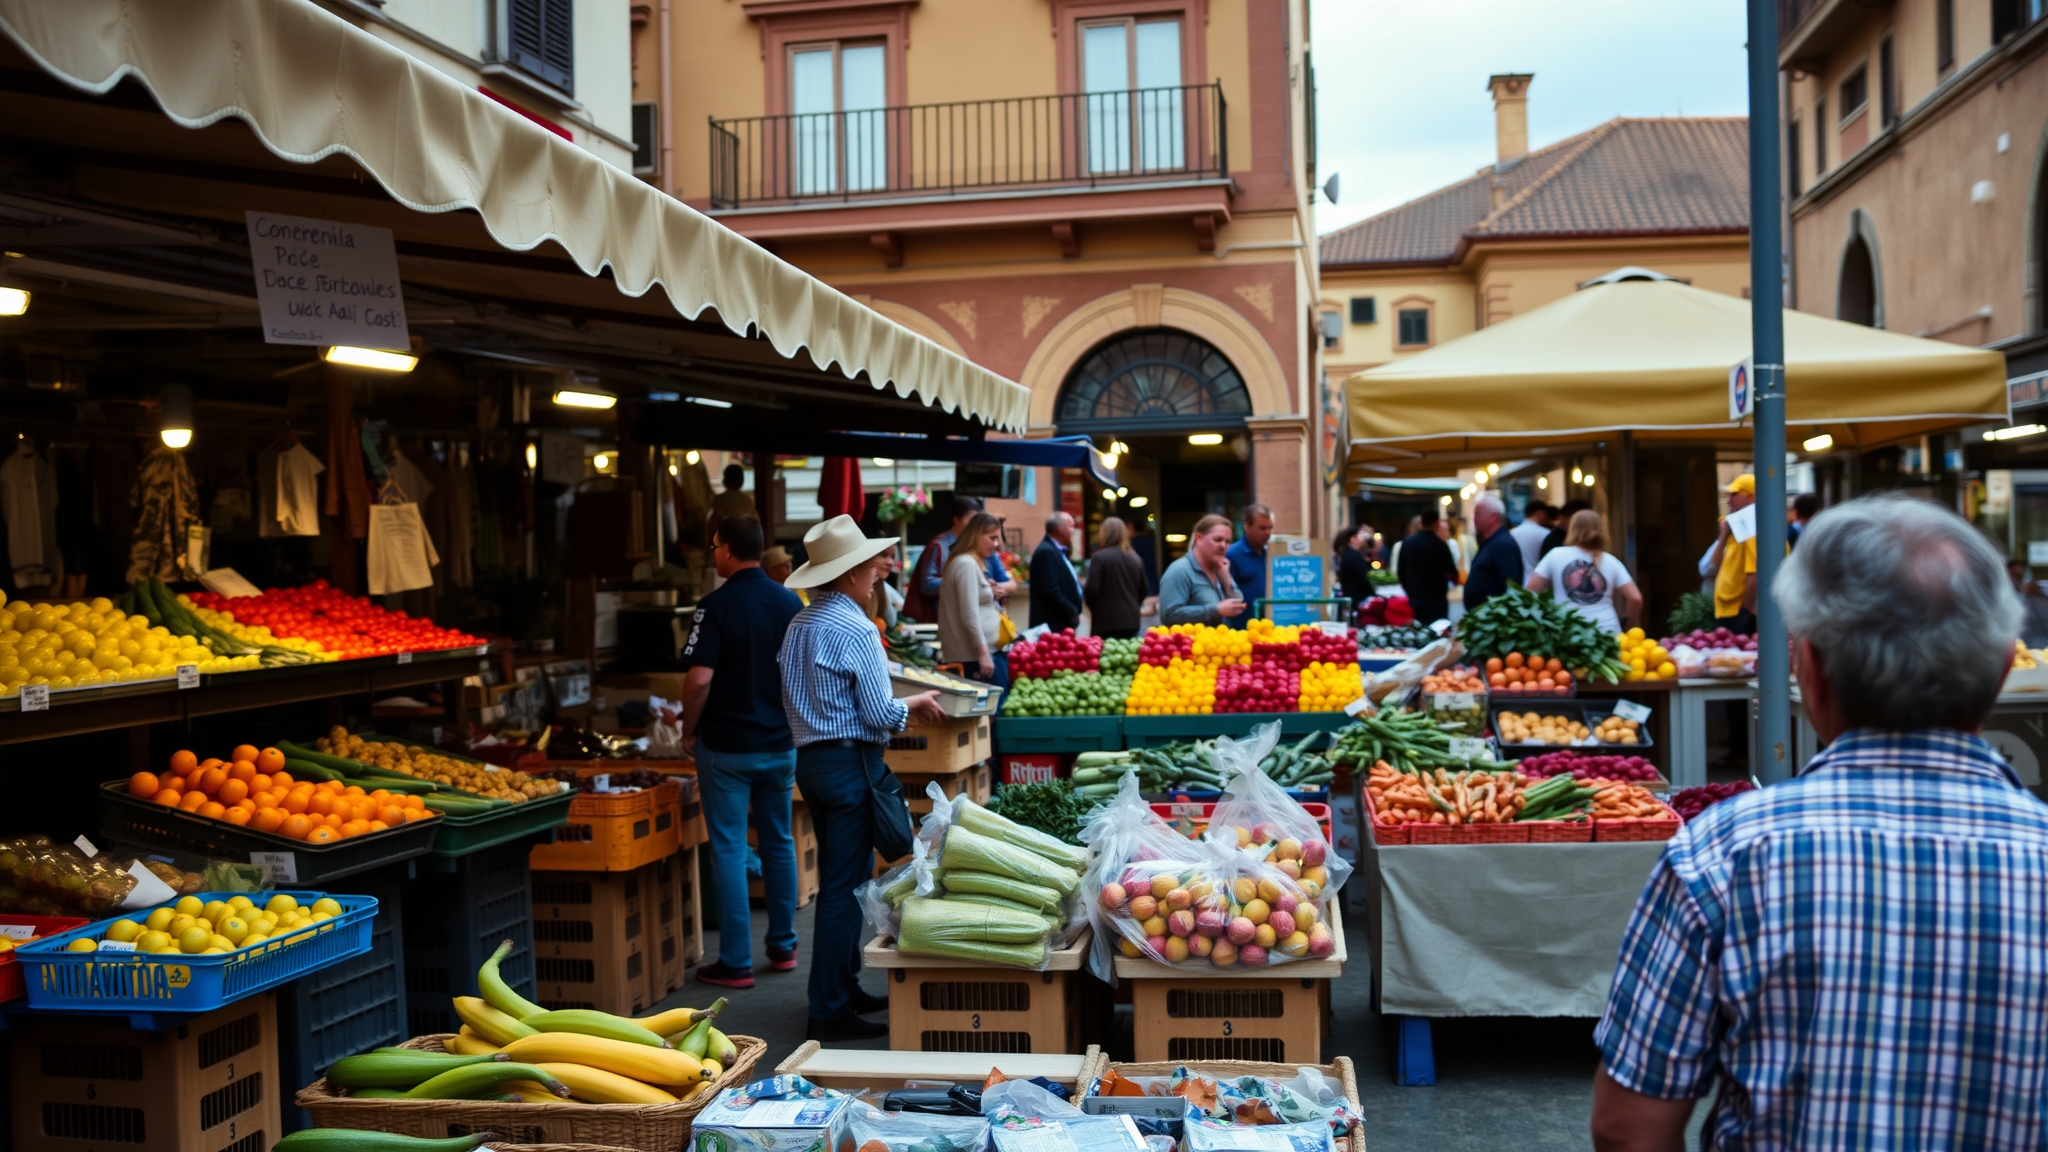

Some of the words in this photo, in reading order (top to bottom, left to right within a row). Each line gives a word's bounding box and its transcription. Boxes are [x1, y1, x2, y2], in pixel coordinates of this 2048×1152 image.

[972, 1014, 980, 1029] 3
[1223, 1021, 1232, 1036] 3
[228, 1063, 234, 1080] 3
[230, 1123, 236, 1140] 3
